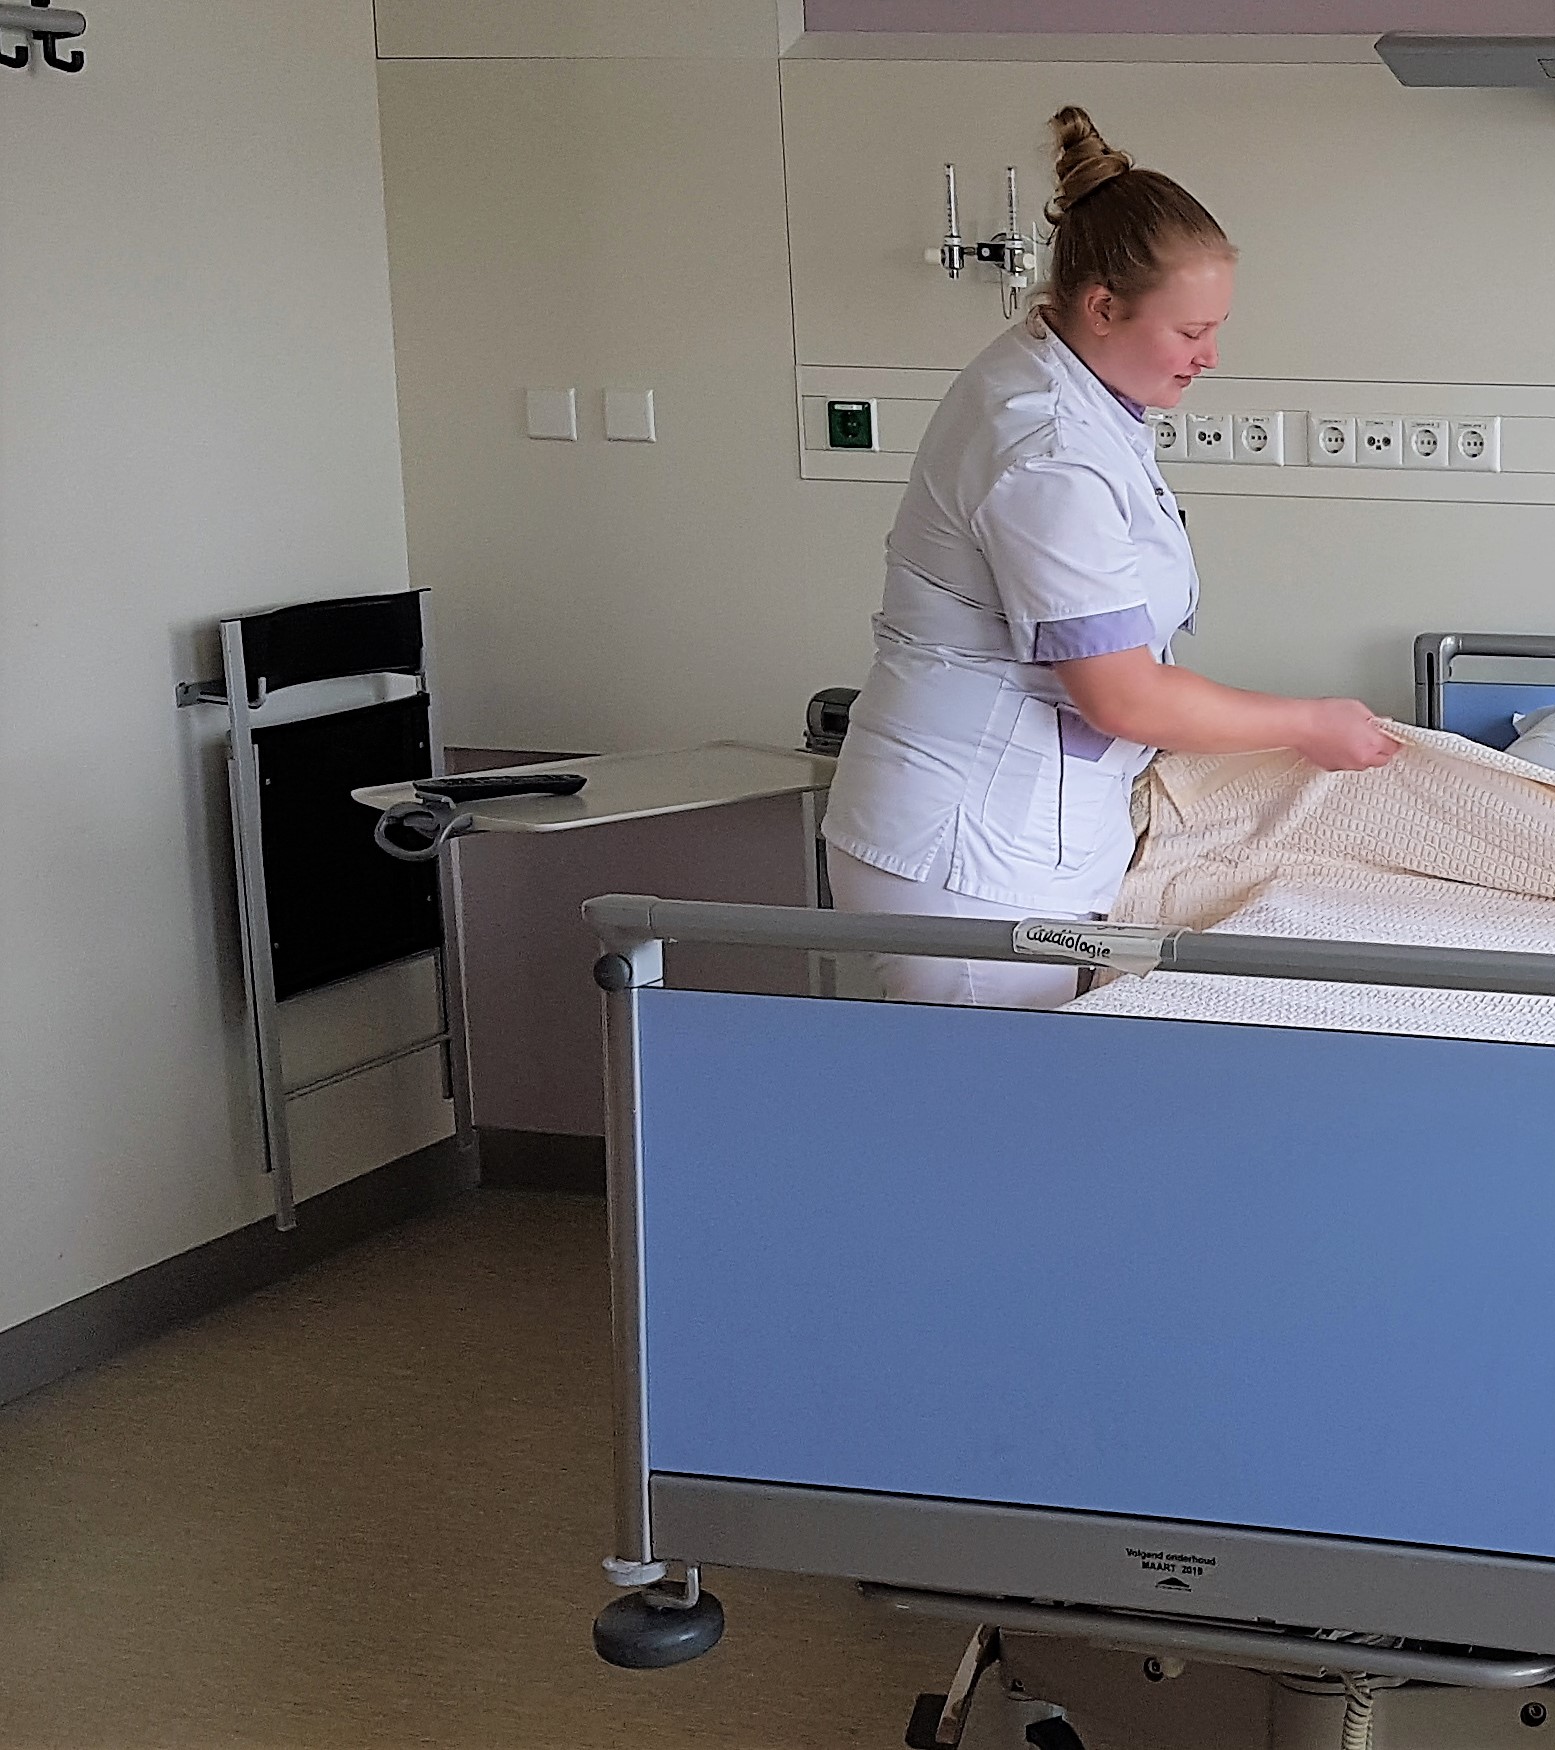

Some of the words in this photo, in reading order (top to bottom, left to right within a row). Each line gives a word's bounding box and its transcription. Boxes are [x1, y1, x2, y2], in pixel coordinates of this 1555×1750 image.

[1026, 925, 1111, 958] Cardiologie
[1125, 1548, 1163, 1560] Volgend
[1166, 1553, 1216, 1566] onderhoud
[1141, 1561, 1175, 1572] MAART
